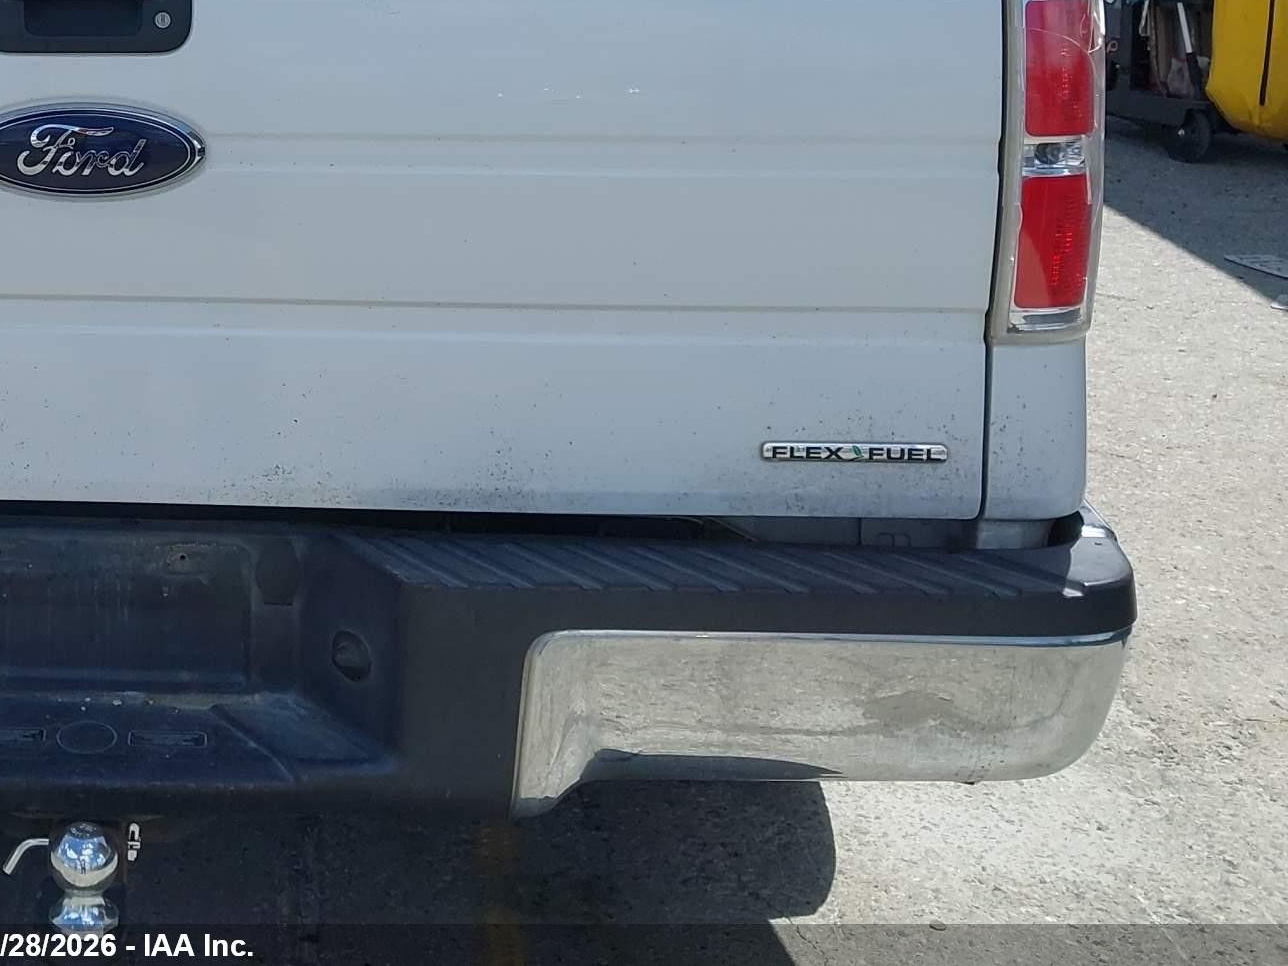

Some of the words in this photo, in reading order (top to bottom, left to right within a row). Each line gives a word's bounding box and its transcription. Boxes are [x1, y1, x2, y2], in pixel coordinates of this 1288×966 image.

[16, 123, 148, 177] Ford
[771, 445, 844, 460] FLEX
[868, 447, 943, 461] FUEL
